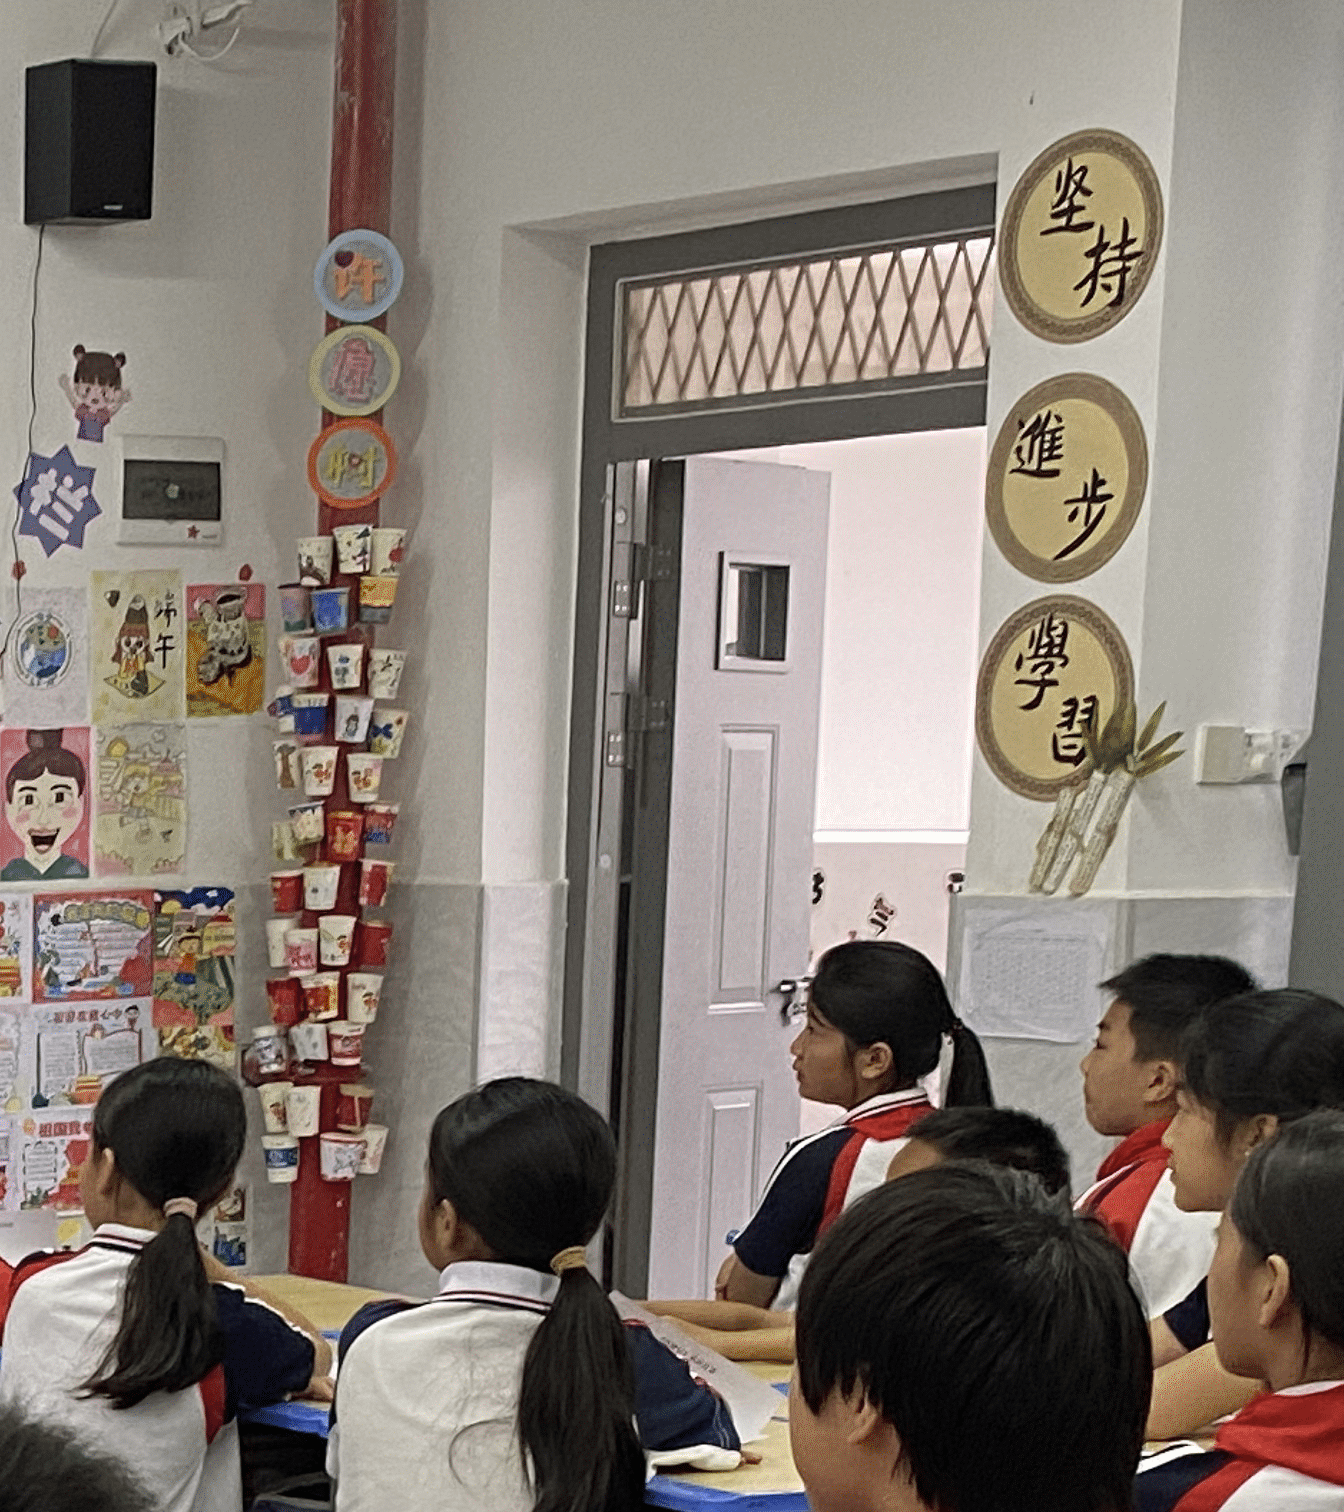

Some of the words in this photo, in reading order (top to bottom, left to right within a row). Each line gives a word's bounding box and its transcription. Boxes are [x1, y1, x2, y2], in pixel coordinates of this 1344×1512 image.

[1040, 157, 1145, 309] 坚持
[154, 588, 178, 670] 端午
[1014, 613, 1099, 768] 學習
